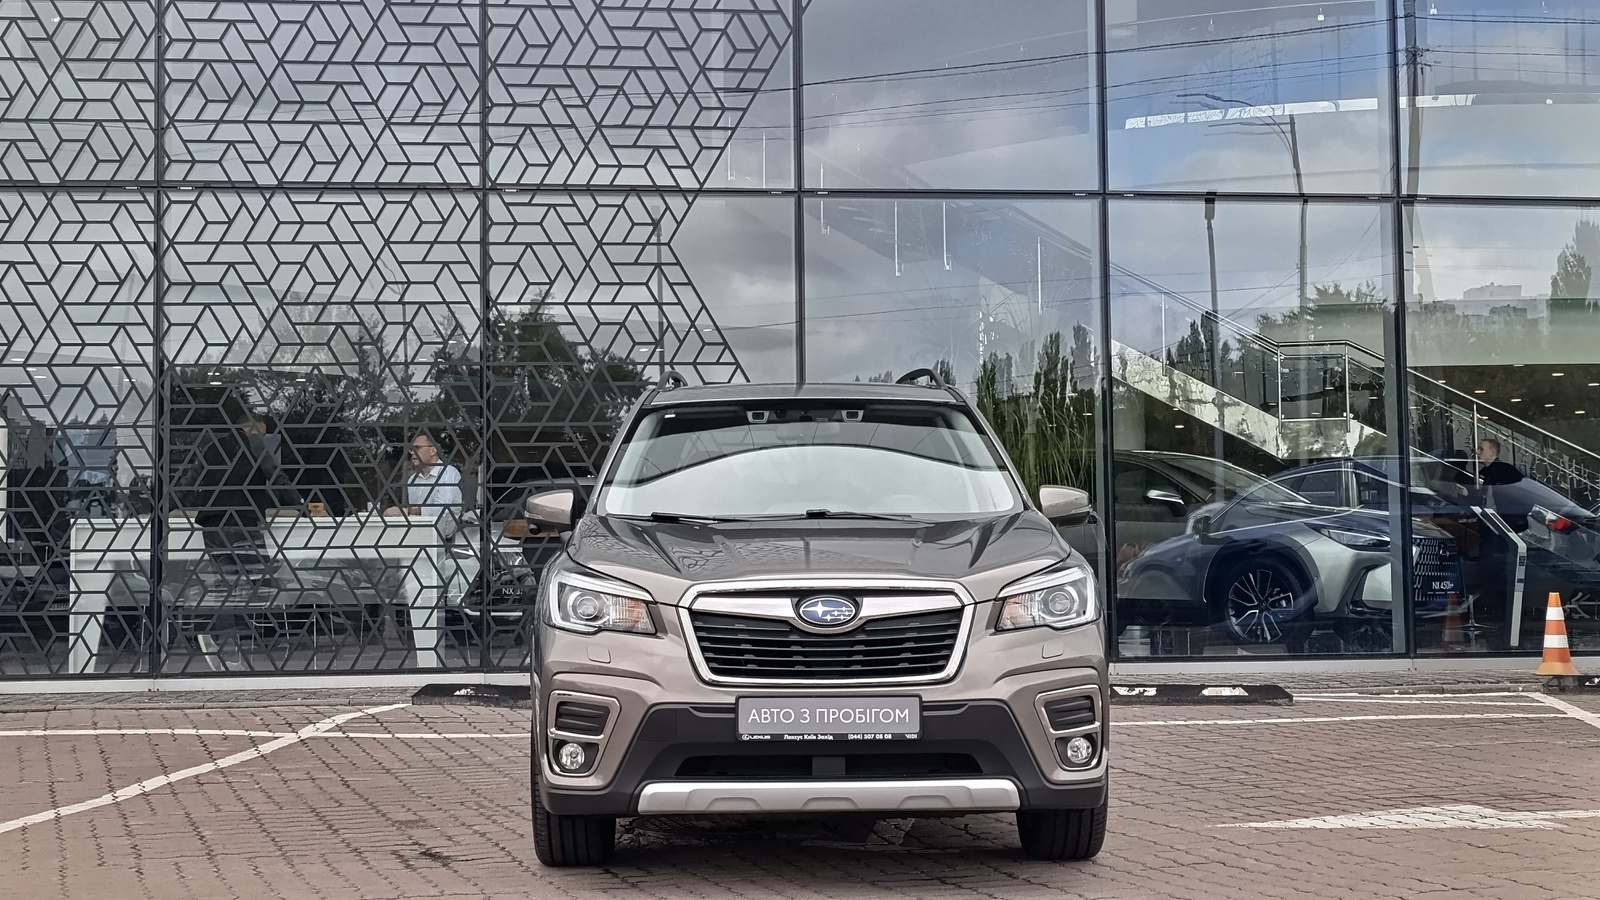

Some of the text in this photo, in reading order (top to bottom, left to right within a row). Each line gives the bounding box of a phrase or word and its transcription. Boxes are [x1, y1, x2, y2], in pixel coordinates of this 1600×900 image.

[1432, 581, 1440, 589] NX
[748, 708, 795, 723] АВТО
[816, 708, 909, 723] ПРОБІГОМ
